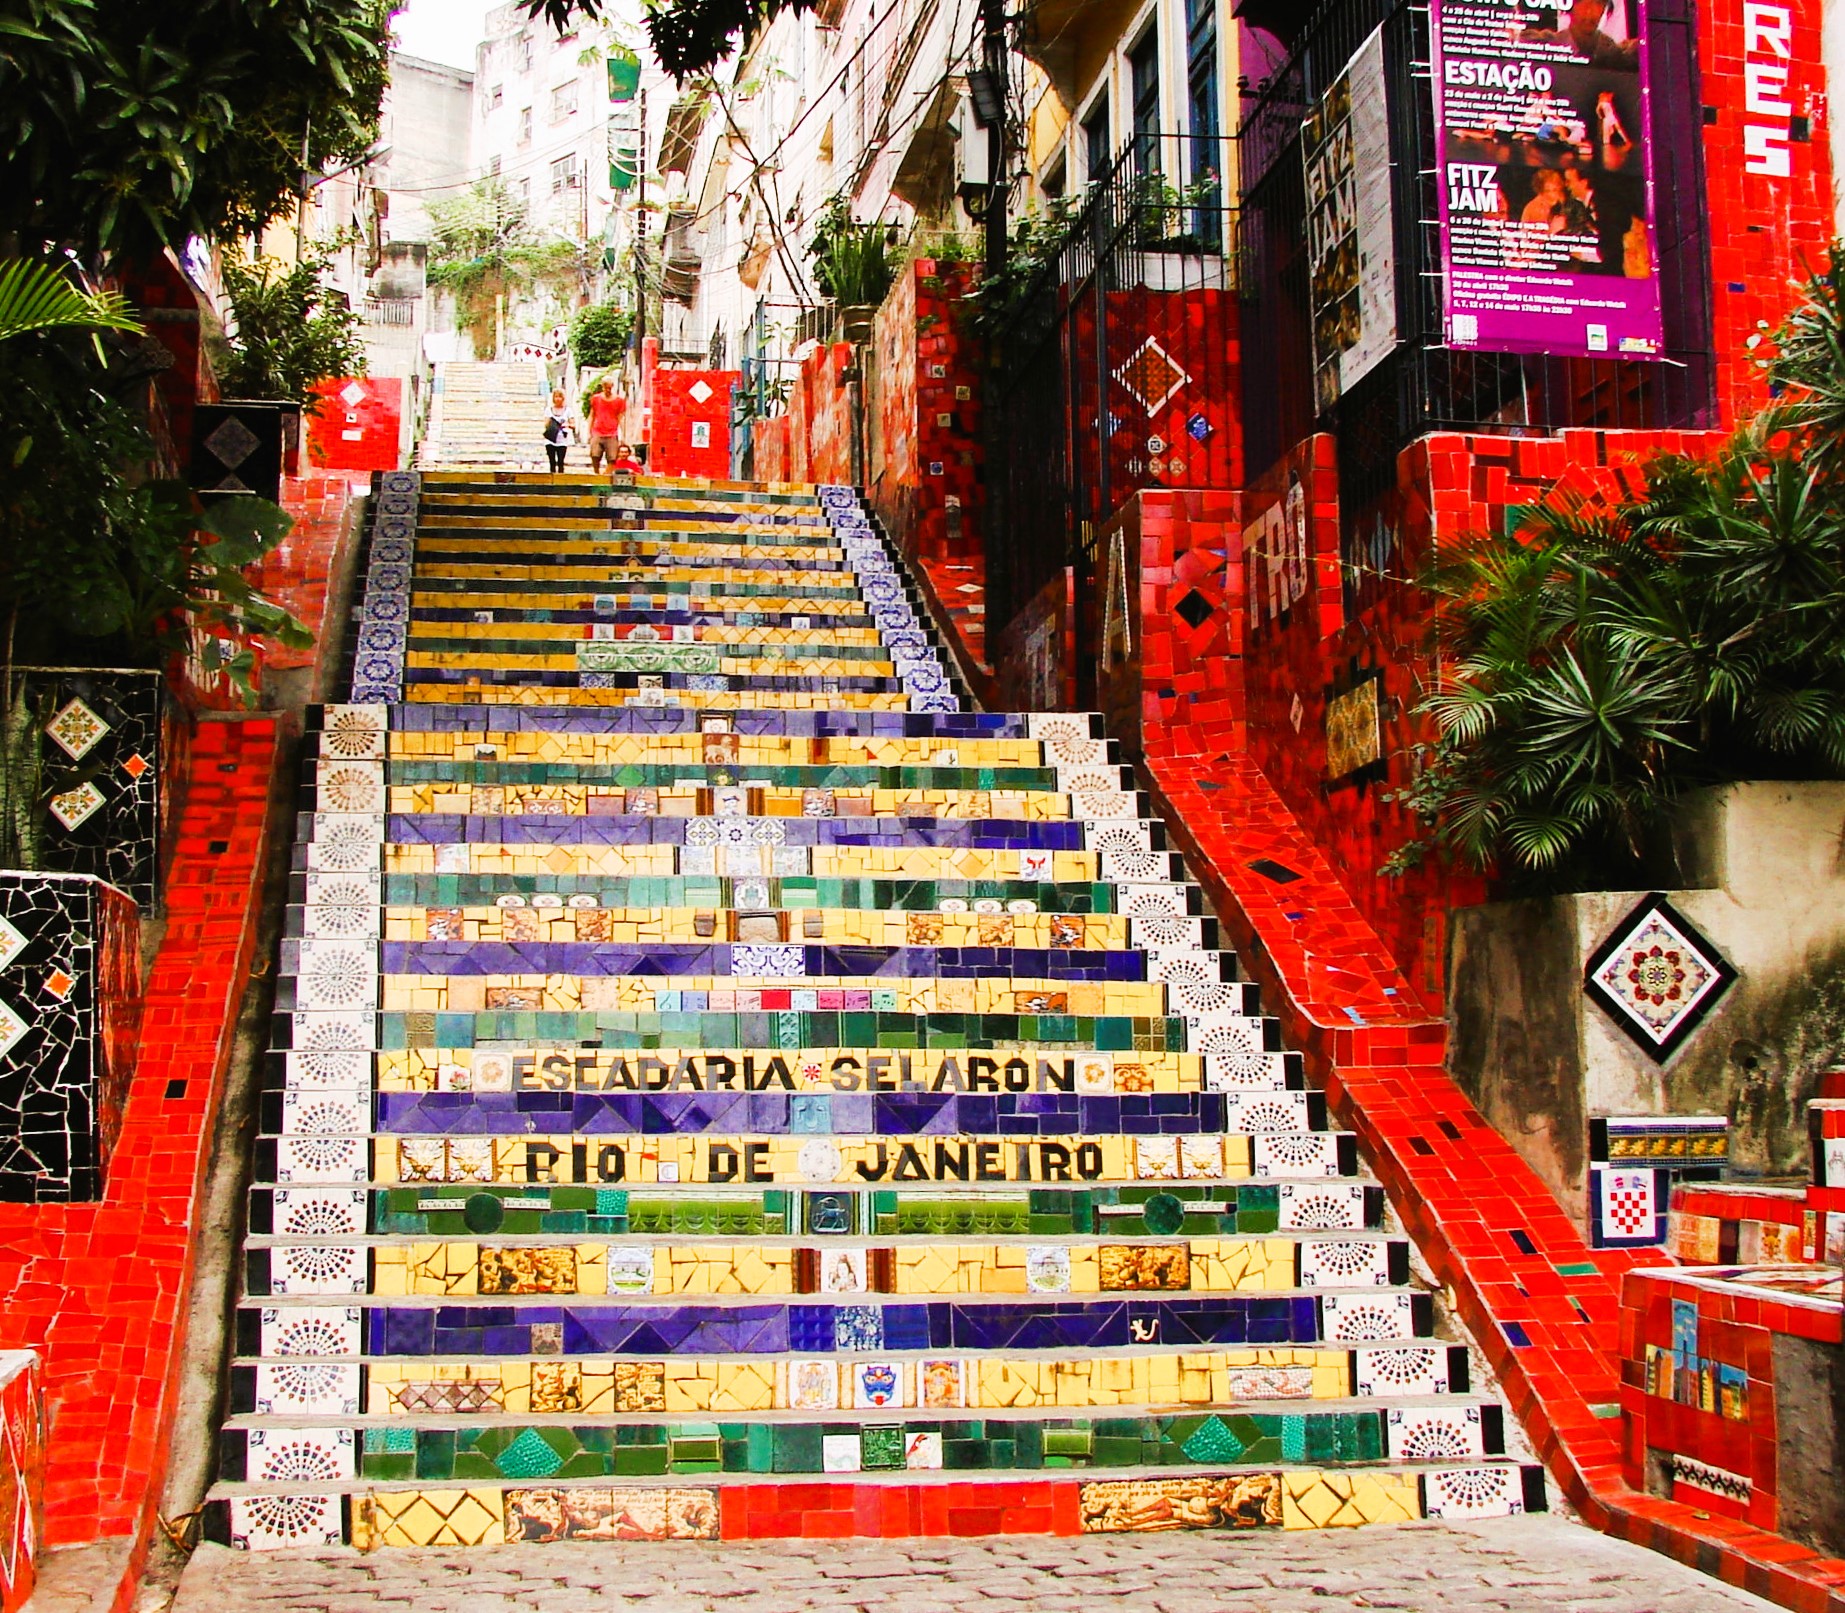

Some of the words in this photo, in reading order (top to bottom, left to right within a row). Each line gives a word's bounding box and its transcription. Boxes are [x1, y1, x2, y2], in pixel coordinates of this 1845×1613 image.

[1444, 60, 1552, 94] ESTAÇÃO
[1308, 122, 1352, 209] FITZ
[1447, 162, 1498, 189] FITZ
[1448, 187, 1499, 213] JAM
[1310, 172, 1357, 277] JAM
[512, 1056, 797, 1091] ESCADARIA
[831, 1055, 1075, 1093] SELARON
[526, 1143, 625, 1184] RIO
[708, 1142, 774, 1183] DE
[857, 1142, 1103, 1182] JANEIRO
